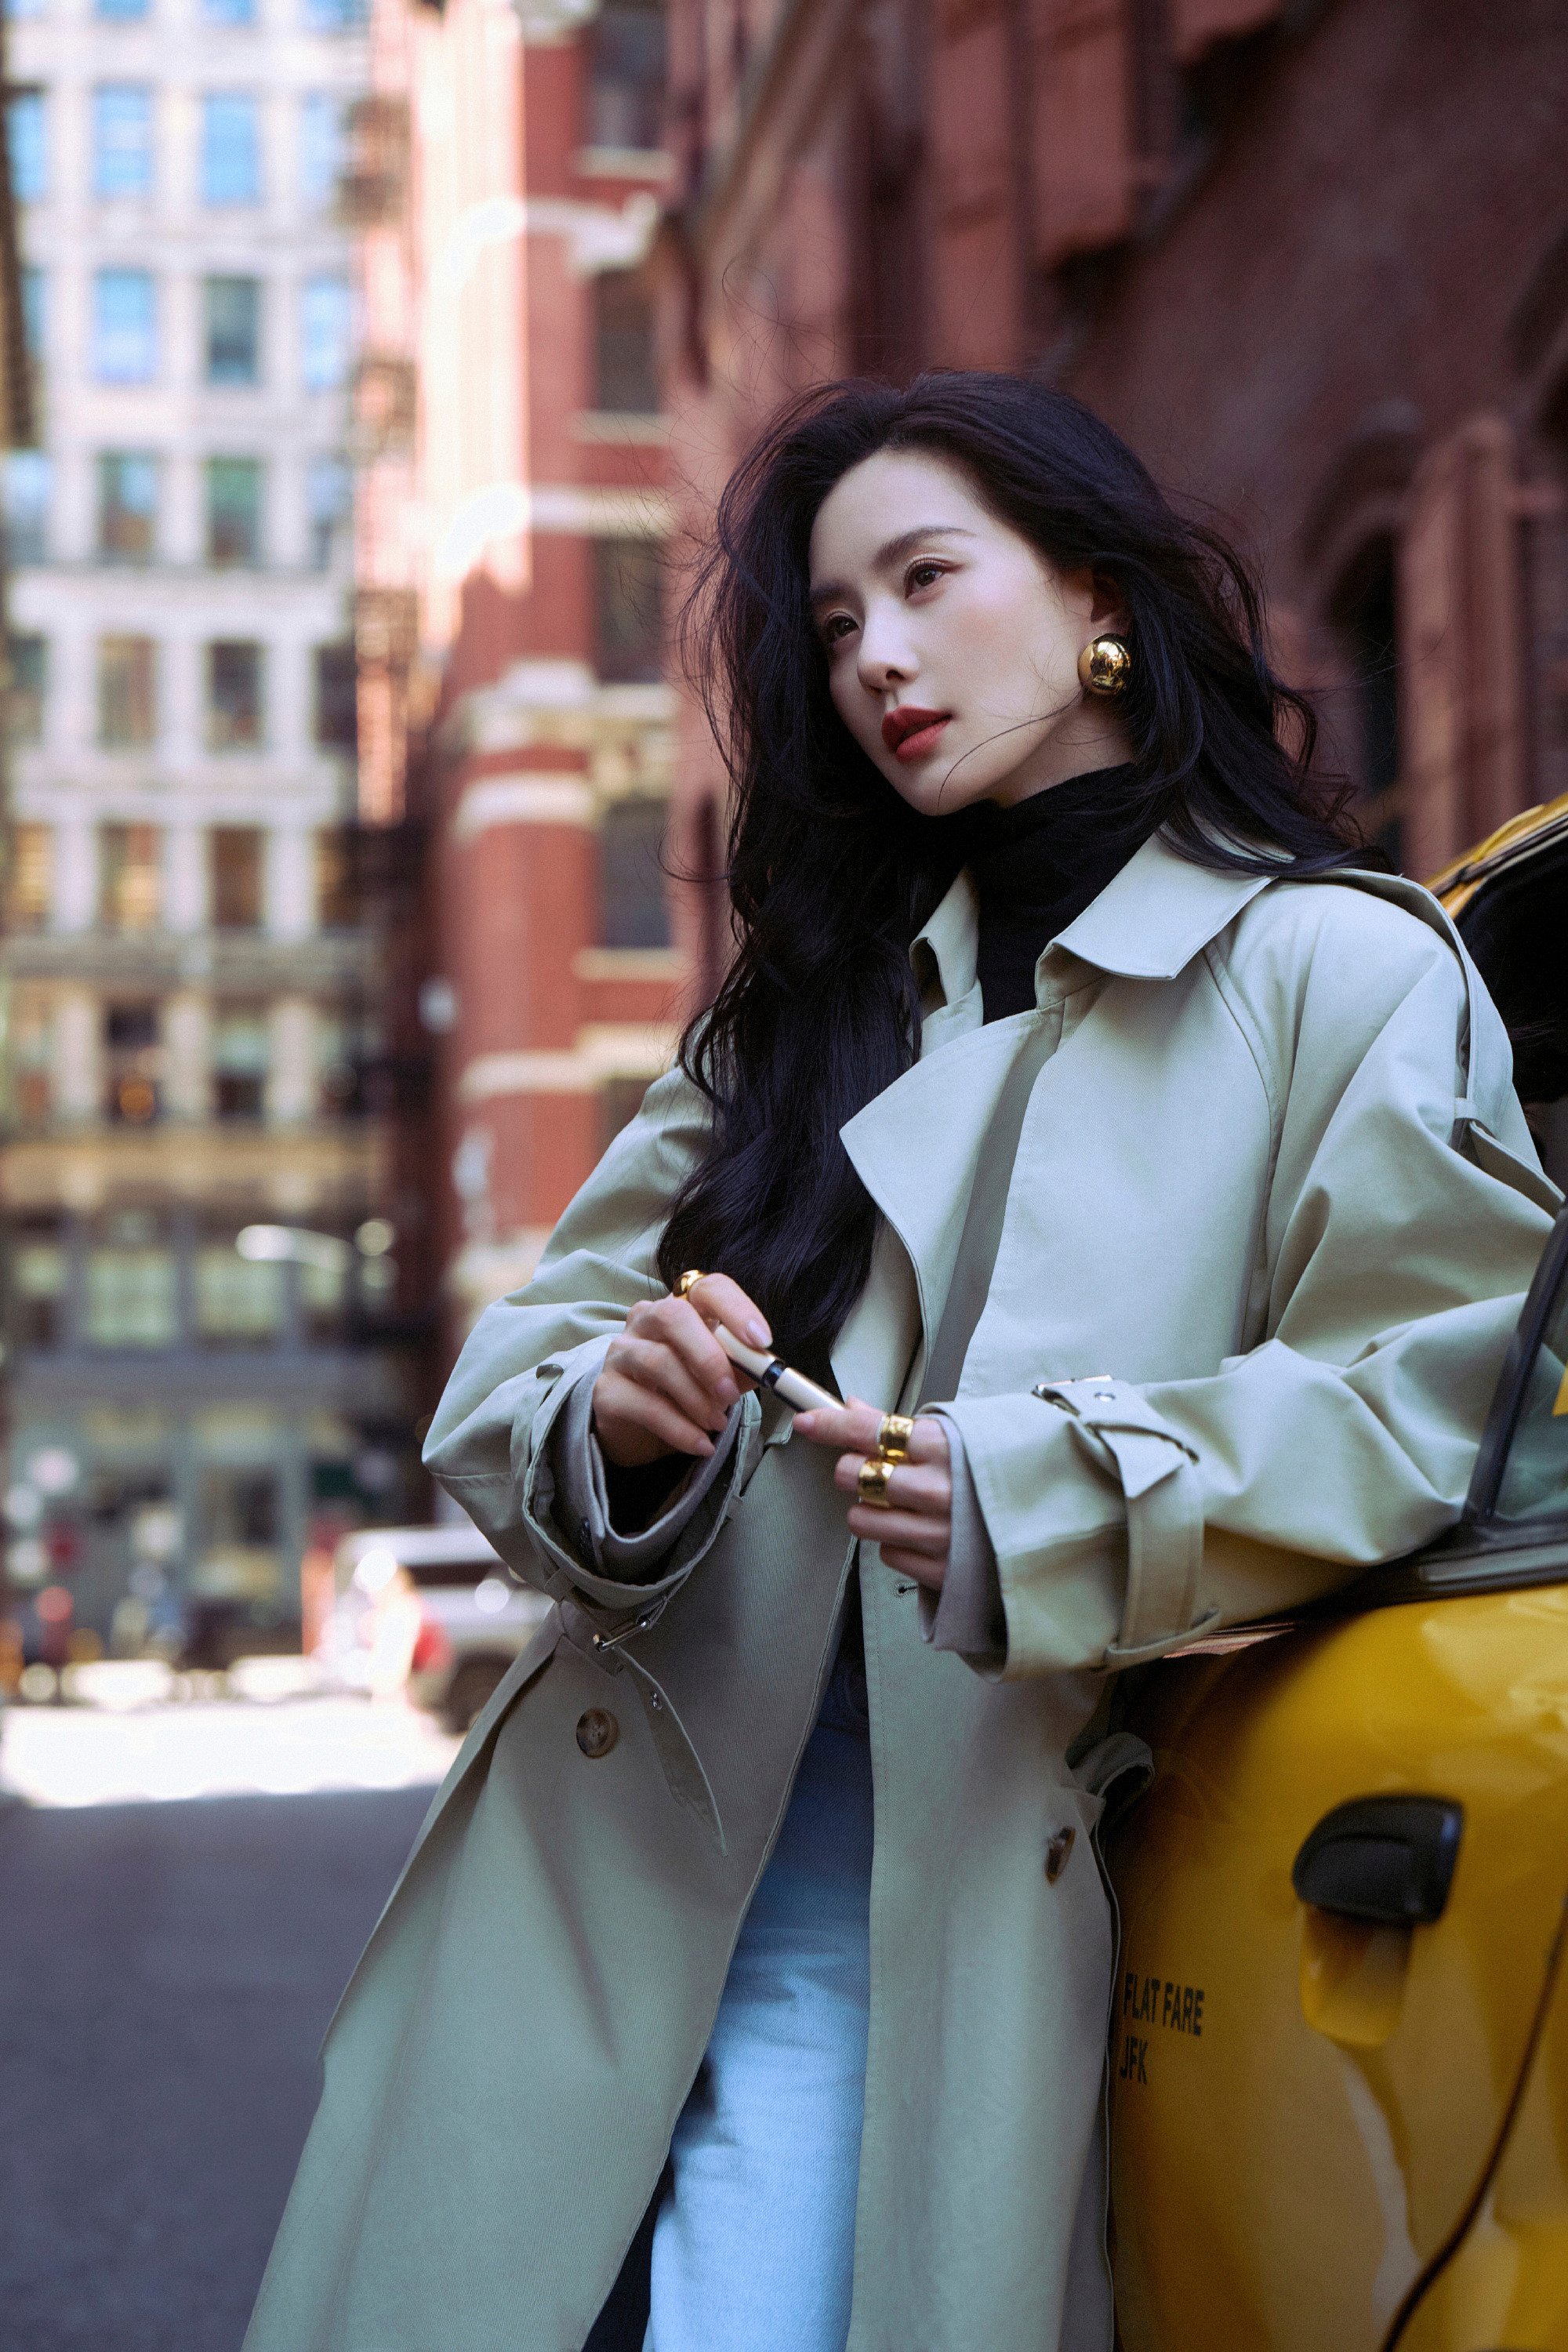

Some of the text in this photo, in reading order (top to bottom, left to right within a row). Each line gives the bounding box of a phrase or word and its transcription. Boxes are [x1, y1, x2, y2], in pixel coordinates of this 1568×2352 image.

[1123, 1973, 1205, 2036] FLAT FARE
[1120, 2035, 1148, 2085] JFK
